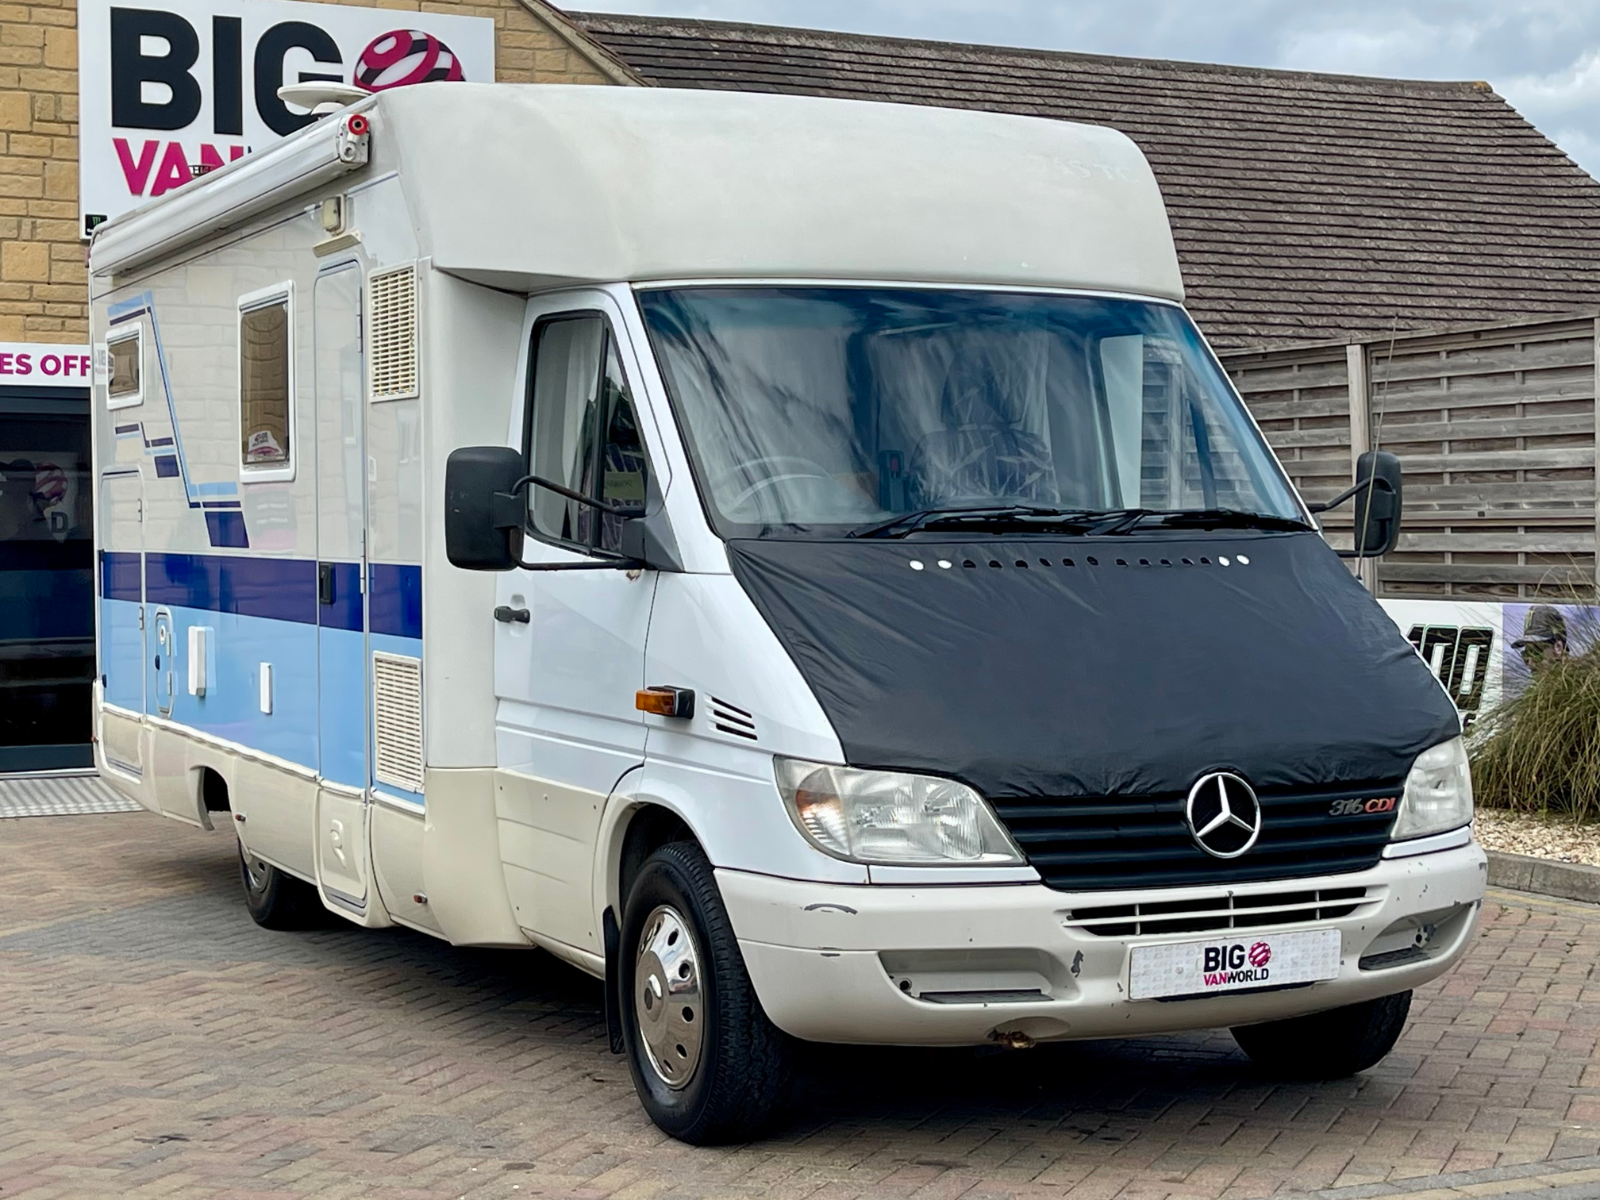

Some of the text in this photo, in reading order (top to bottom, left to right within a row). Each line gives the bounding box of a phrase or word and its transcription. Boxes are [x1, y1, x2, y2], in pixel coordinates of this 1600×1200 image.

[110, 7, 343, 136] BIG
[1329, 797, 1396, 816] 316 CDI
[1203, 944, 1245, 972] BIG
[1203, 967, 1269, 986] VANWORLD
